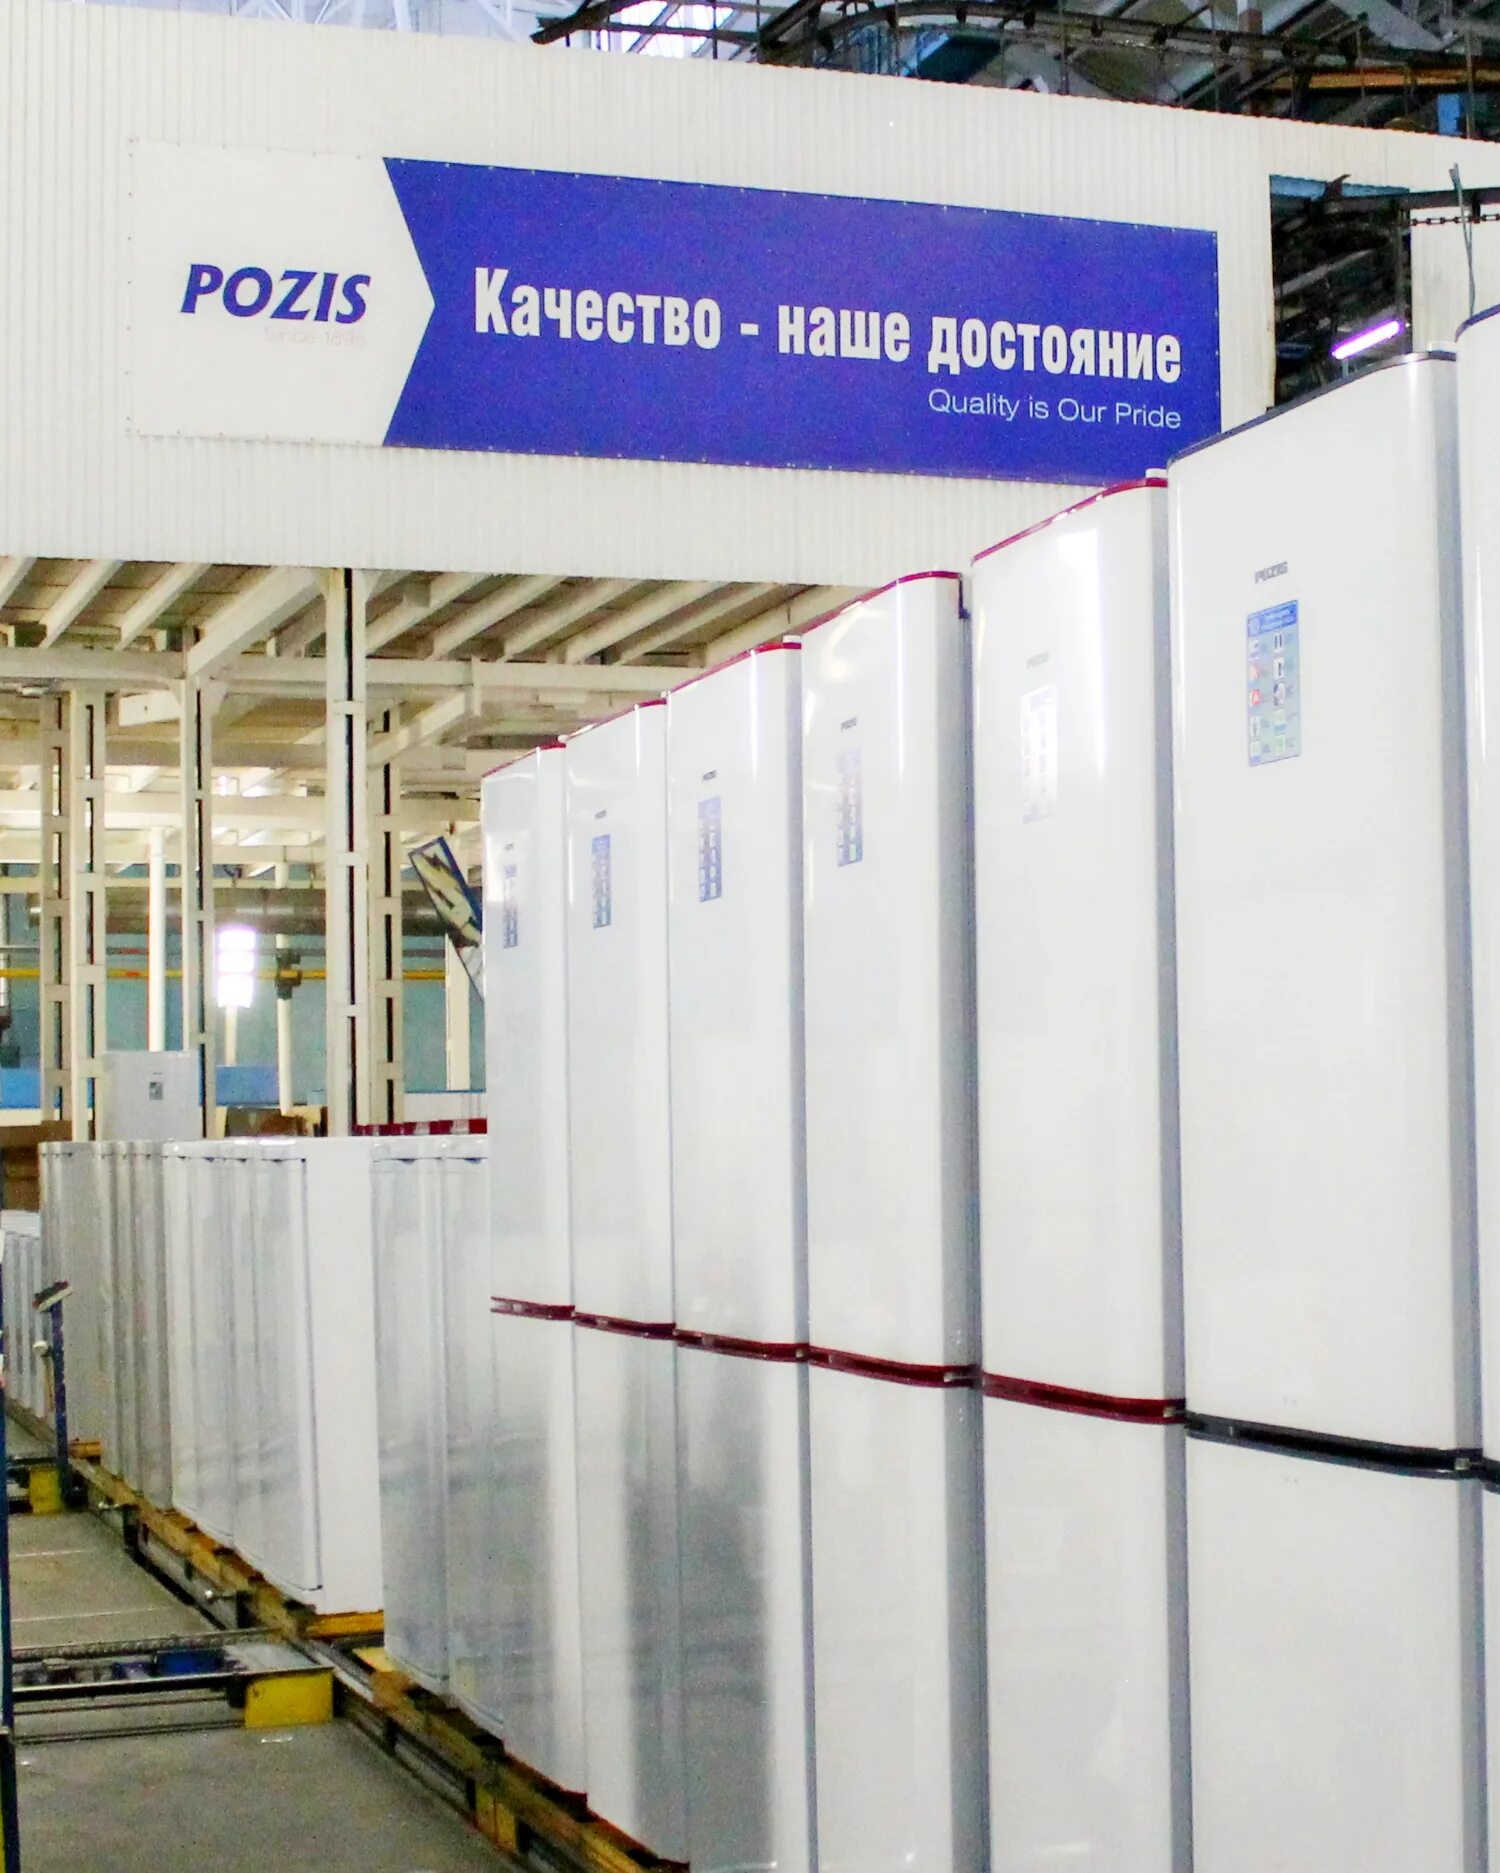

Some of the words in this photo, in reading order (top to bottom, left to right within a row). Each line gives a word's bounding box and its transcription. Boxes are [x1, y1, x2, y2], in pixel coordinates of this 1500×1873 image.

[181, 263, 371, 324] POZIS
[474, 266, 722, 350] Качество
[739, 322, 760, 336] -
[778, 304, 911, 363] наше
[927, 316, 1181, 384] достояние
[928, 388, 1021, 421] Quality
[1028, 396, 1050, 419] is
[1057, 397, 1106, 422] Our
[1115, 402, 1182, 428] Pride
